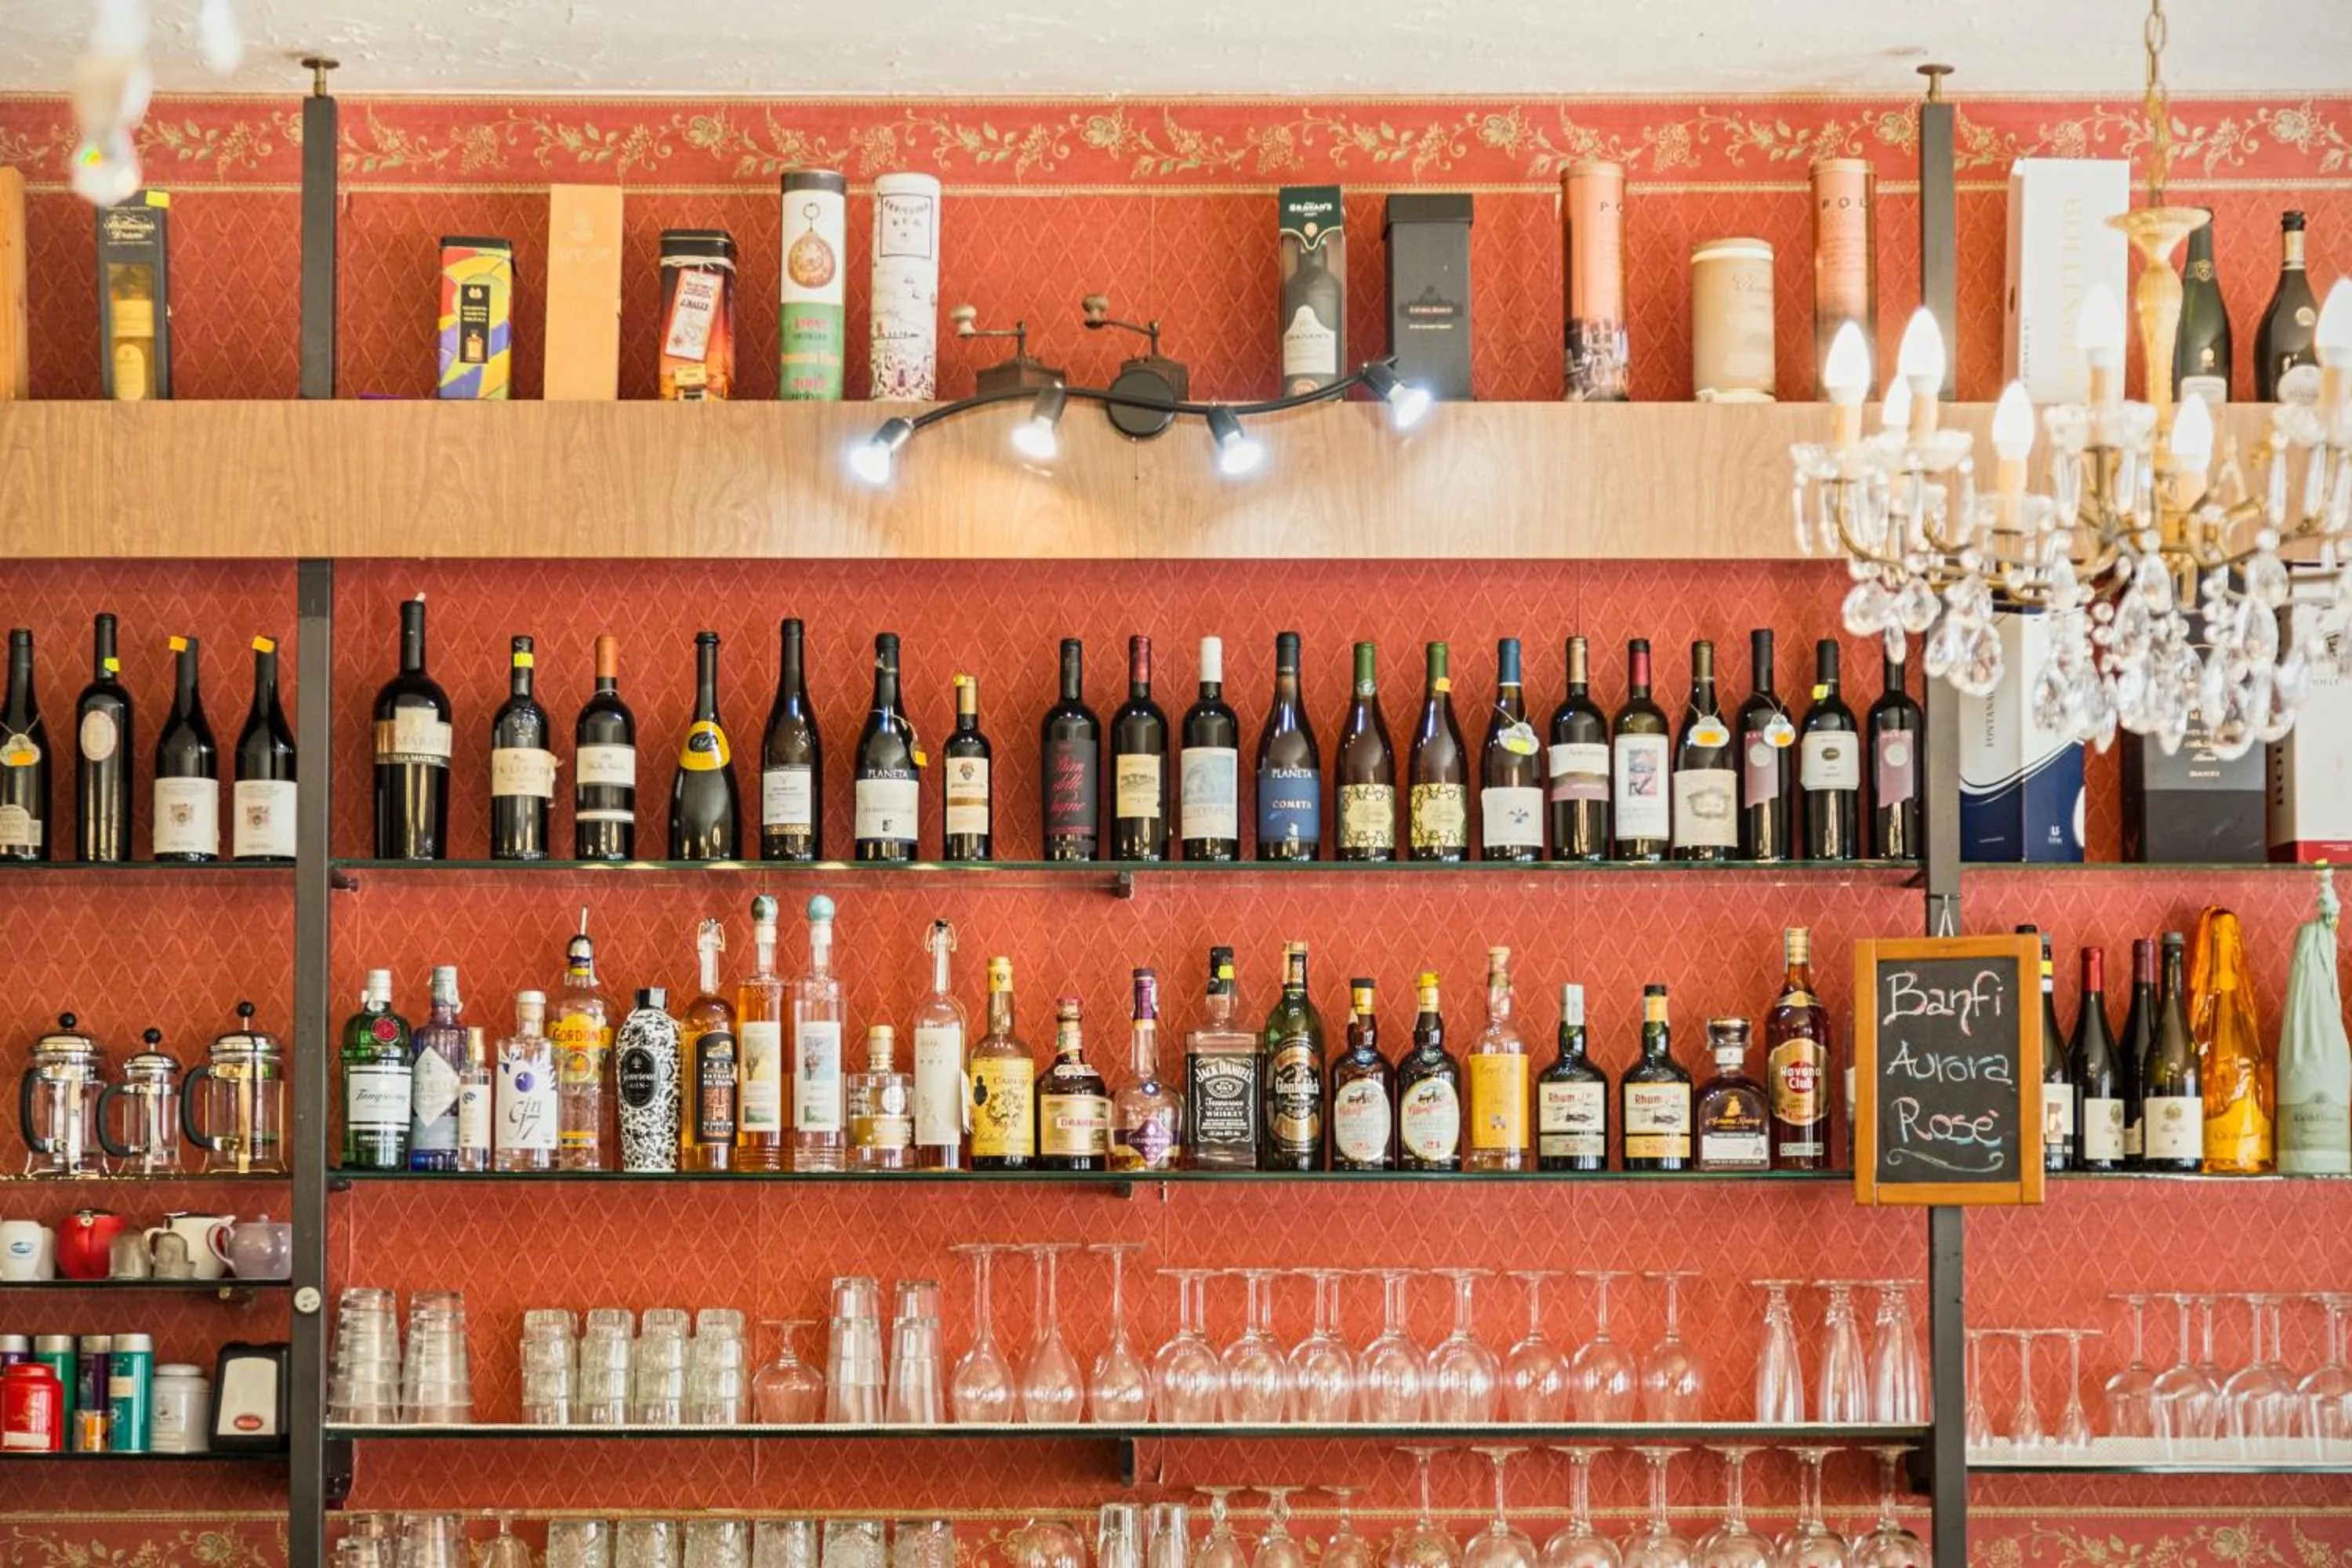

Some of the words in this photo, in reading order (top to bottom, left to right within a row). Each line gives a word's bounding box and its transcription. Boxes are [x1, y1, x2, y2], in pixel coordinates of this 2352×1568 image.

[868, 769, 909, 779] PLANETA
[1272, 768, 1312, 779] PLANETA
[1272, 800, 1312, 809] COMETA
[1883, 970, 2004, 1036] Banfi
[1886, 1040, 2013, 1085] Aurora
[1196, 1065, 1218, 1083] JACK
[1780, 1065, 1821, 1077] Havana
[1788, 1077, 1814, 1090] Club
[1891, 1096, 2002, 1147] Rosé
